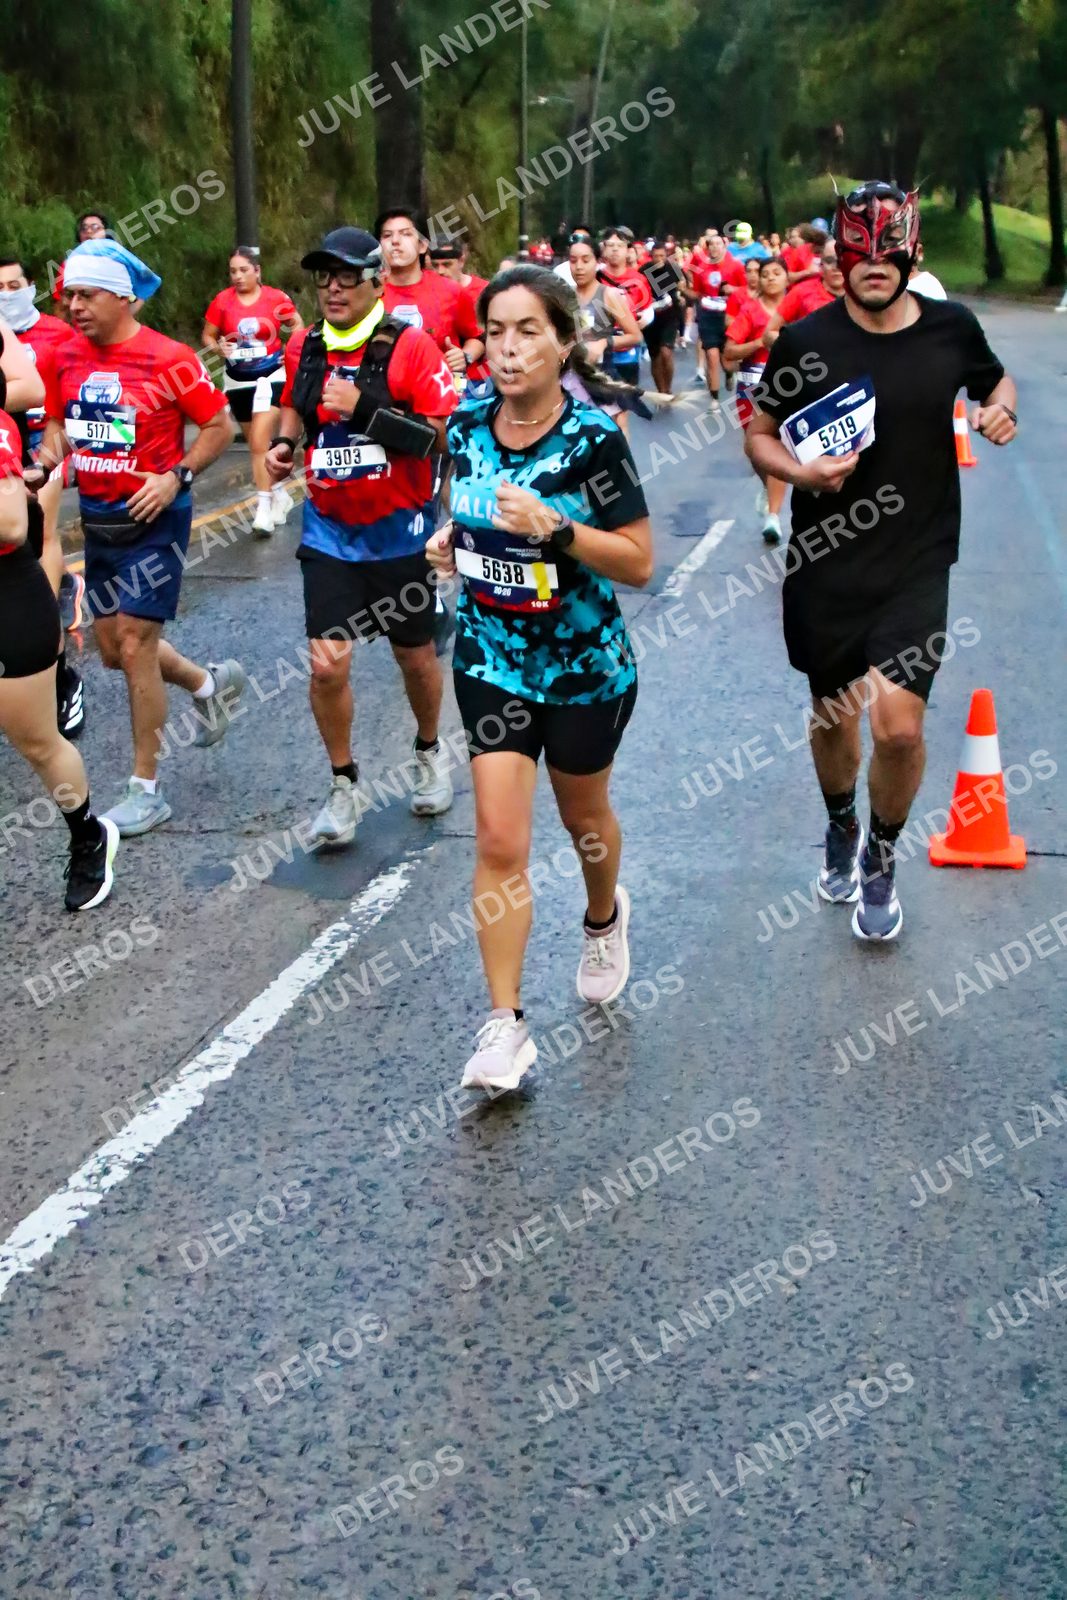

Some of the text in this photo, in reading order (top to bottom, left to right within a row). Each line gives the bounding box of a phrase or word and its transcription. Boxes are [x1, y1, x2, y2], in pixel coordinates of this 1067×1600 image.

[87, 422, 110, 440] 5171
[818, 415, 857, 449] 5219
[326, 448, 362, 466] 3903
[482, 558, 524, 585] 5638
